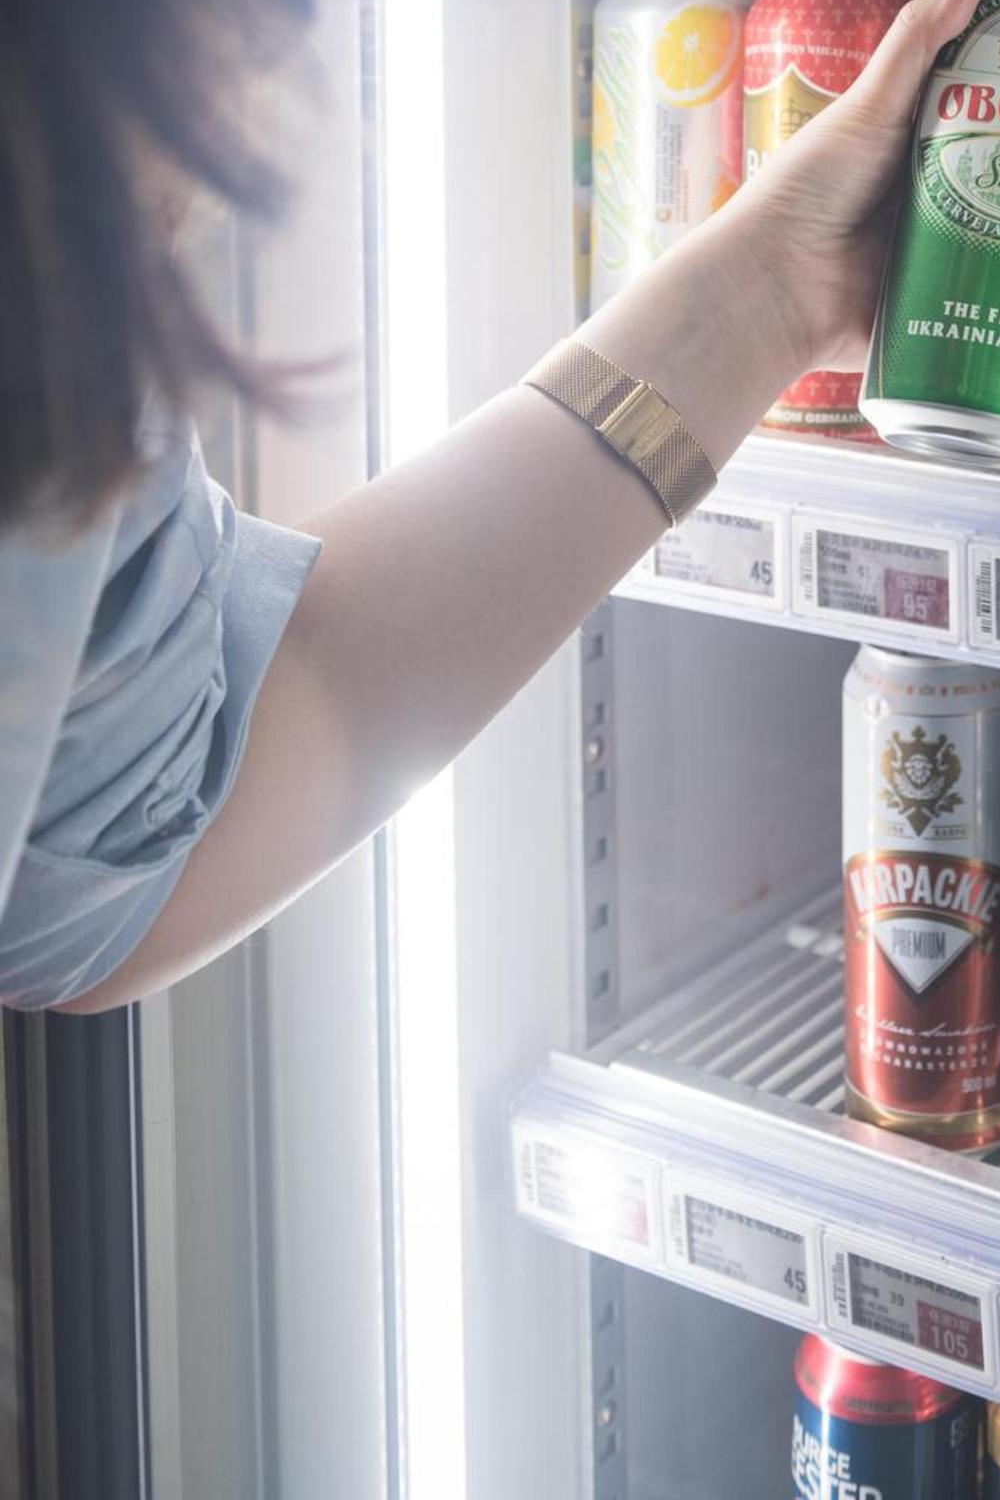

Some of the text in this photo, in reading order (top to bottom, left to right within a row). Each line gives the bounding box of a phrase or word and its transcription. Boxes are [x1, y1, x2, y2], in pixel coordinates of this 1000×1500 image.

[942, 301, 984, 323] THE
[804, 408, 865, 423] GERMANY
[750, 561, 773, 586] 45
[903, 593, 930, 619] 95
[892, 927, 946, 960] PREMIUM
[784, 1266, 806, 1294] 45
[930, 1326, 969, 1359] 105
